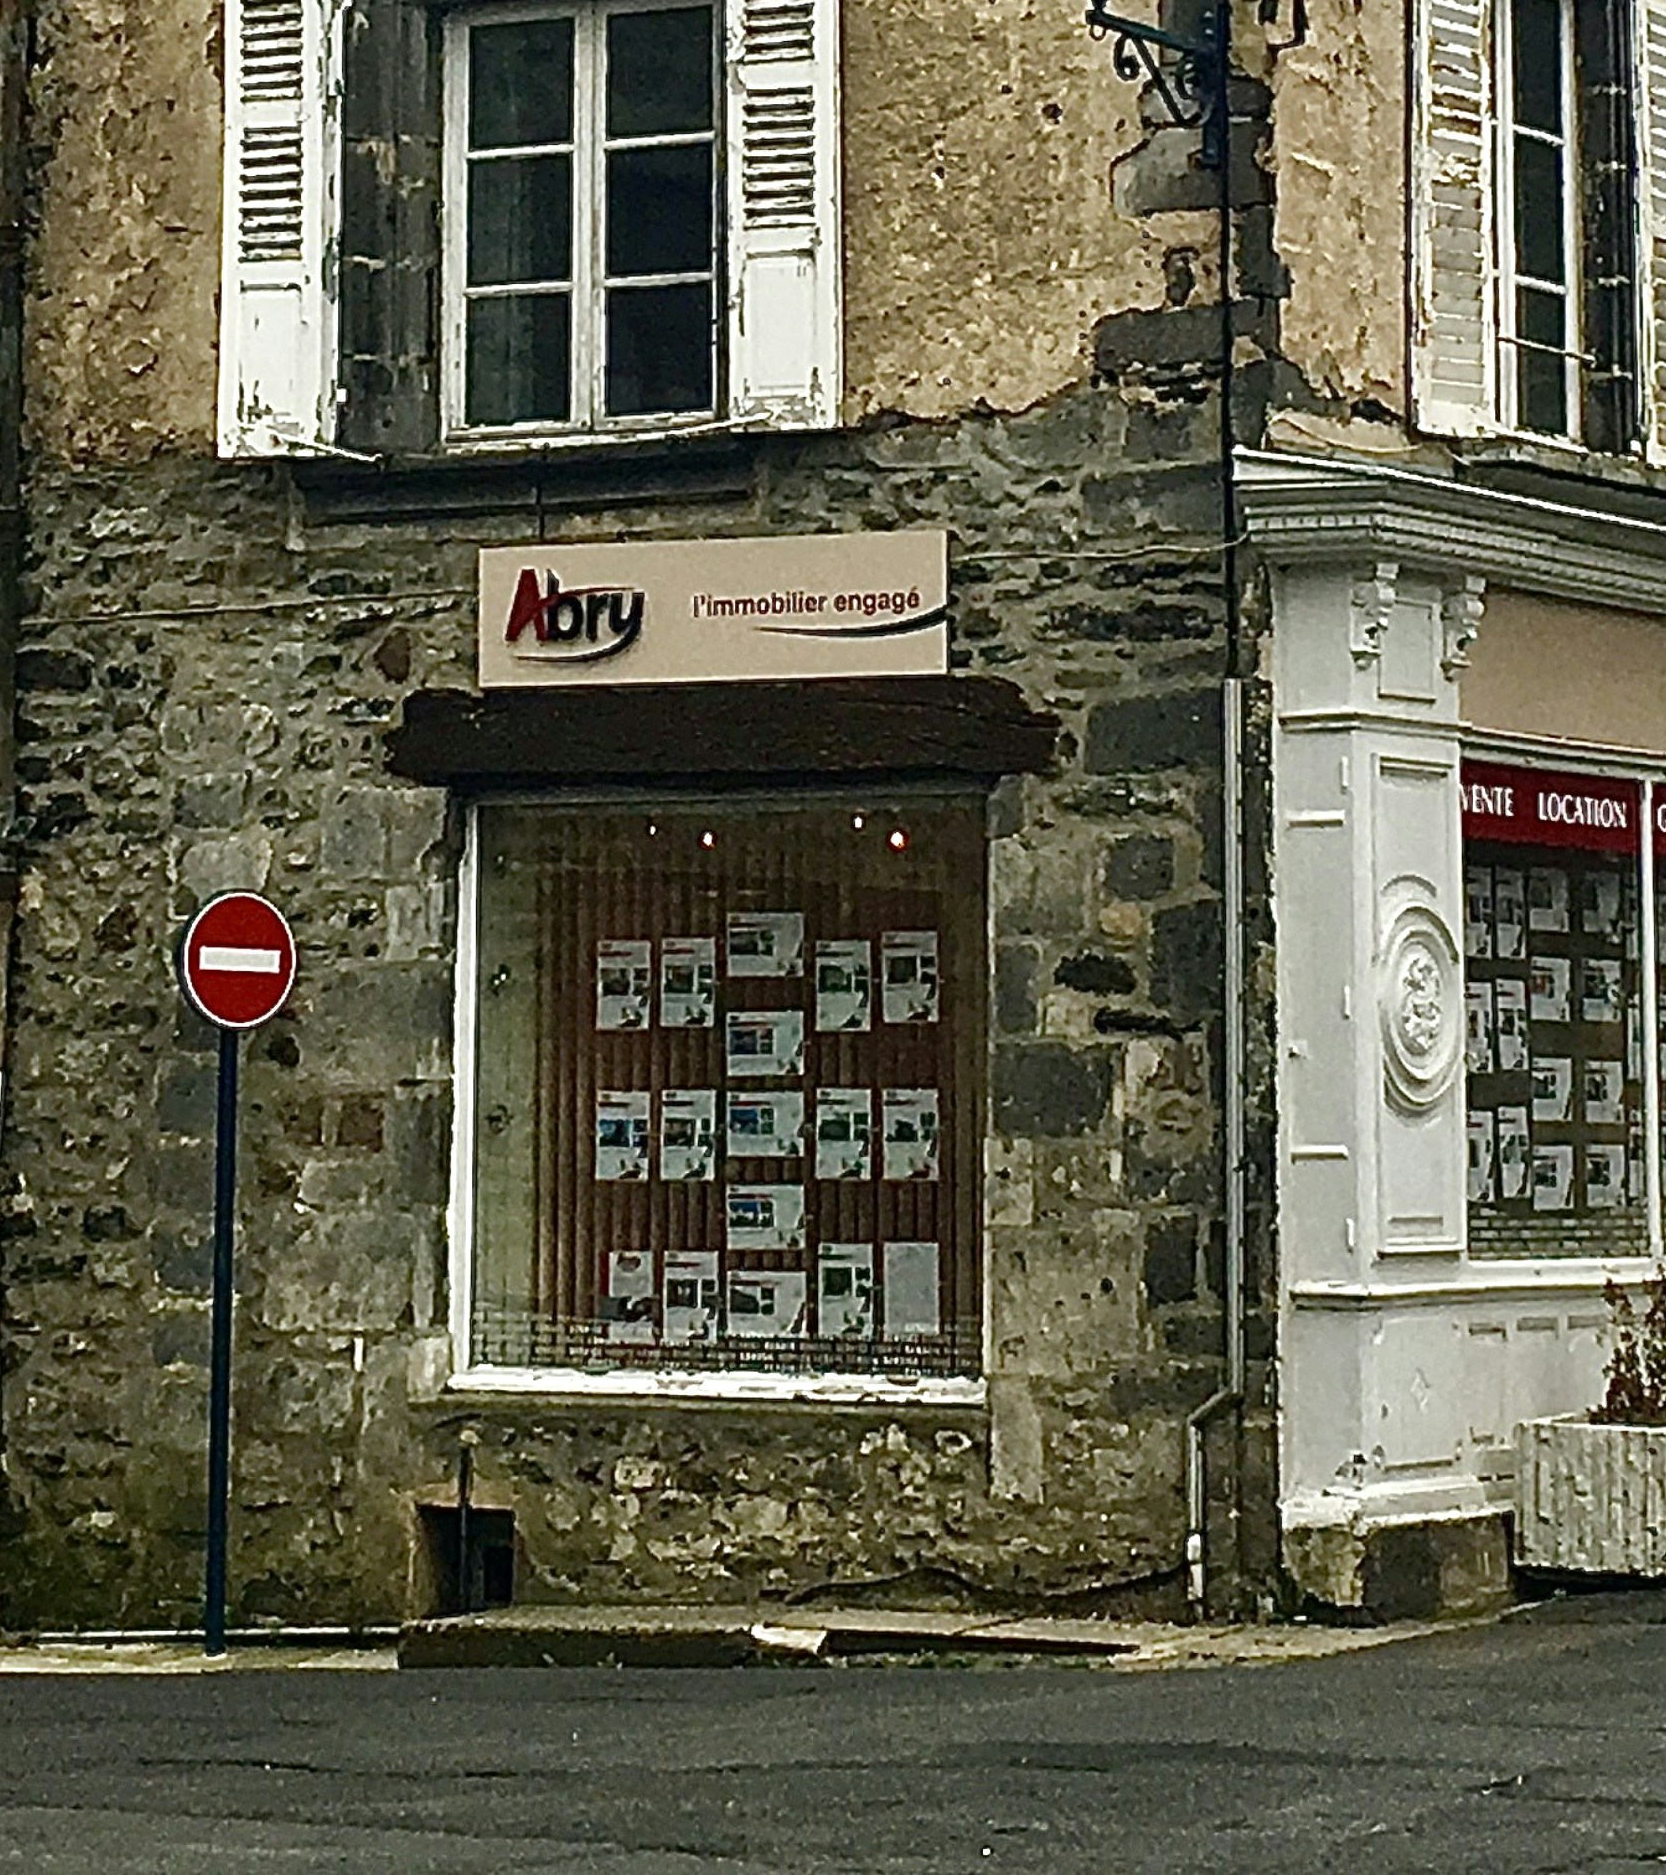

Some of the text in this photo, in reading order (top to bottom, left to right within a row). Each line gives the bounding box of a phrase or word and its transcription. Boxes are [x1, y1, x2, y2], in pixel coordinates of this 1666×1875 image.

[505, 567, 920, 662] Abry l'immobilier engagé
[1460, 784, 1515, 818] VENTE
[1538, 792, 1628, 828] LOCATION
